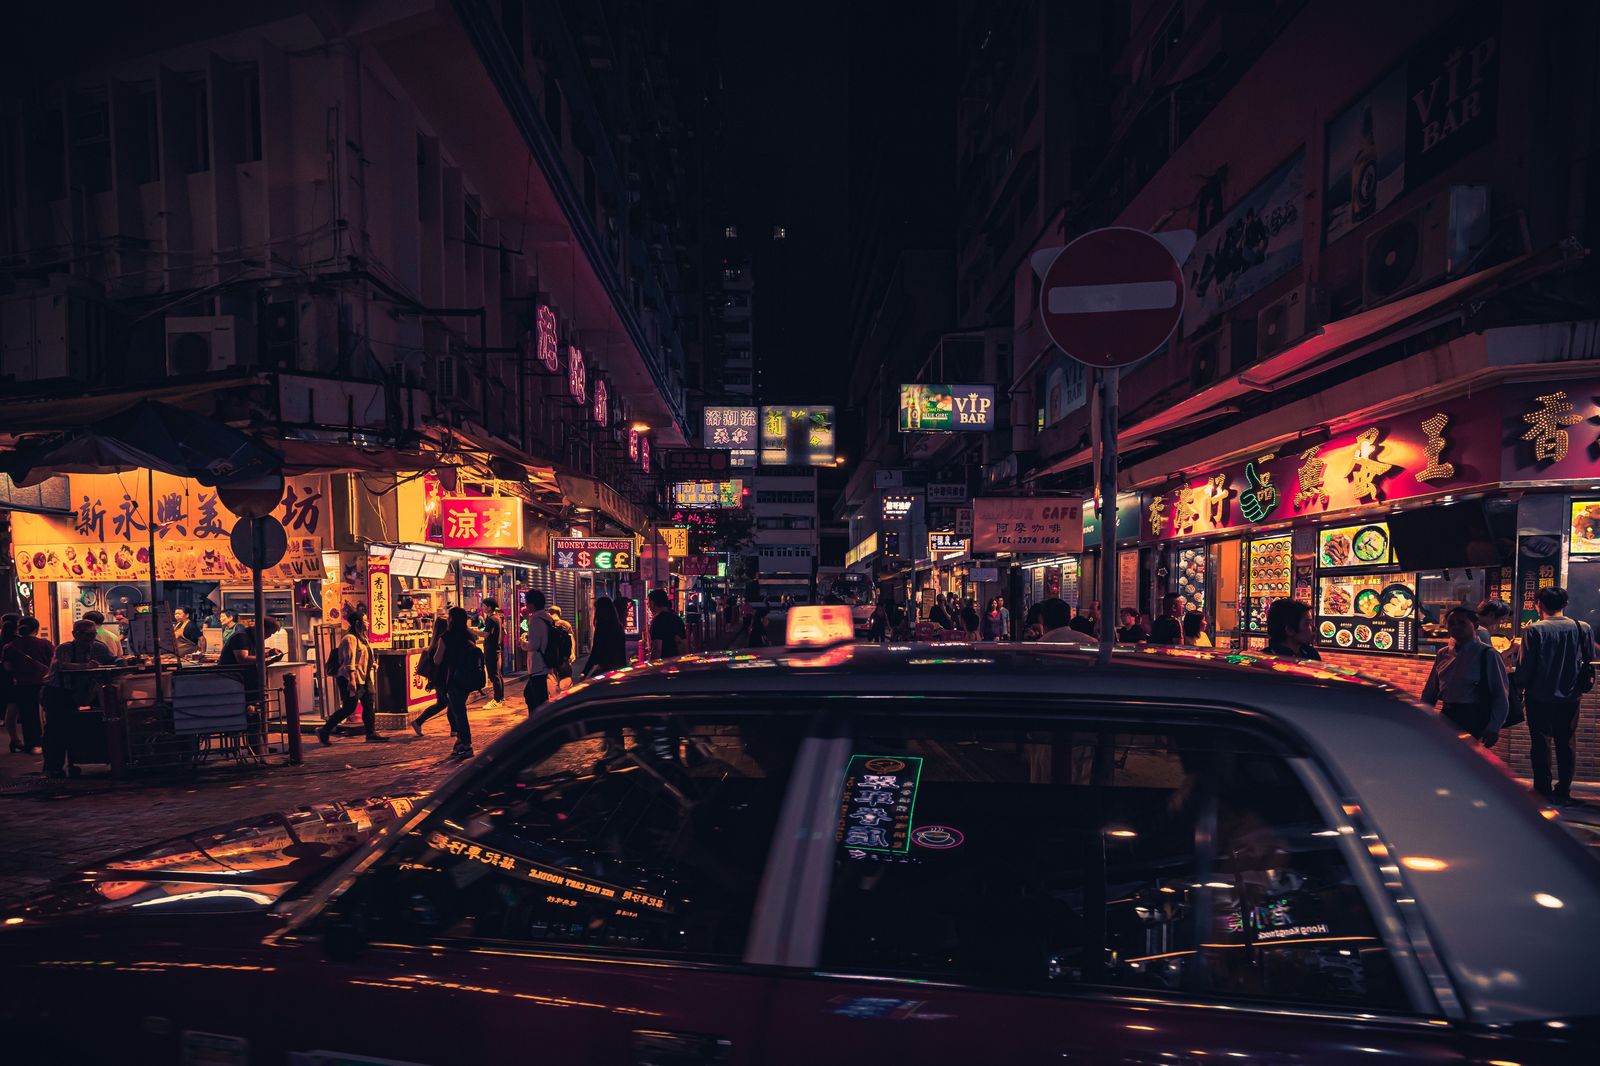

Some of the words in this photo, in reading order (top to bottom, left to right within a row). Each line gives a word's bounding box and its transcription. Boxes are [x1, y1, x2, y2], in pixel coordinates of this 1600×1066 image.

[1412, 37, 1494, 124] VIP
[1421, 92, 1481, 152] BAR
[954, 397, 992, 413] VIP
[1066, 383, 1082, 405] BAR
[959, 413, 986, 424] BAR
[1521, 391, 1600, 462] 香
[75, 485, 322, 542] 新永興美坊
[447, 508, 513, 539] 涼茶
[1042, 507, 1078, 520] CAFE
[557, 541, 585, 550] MONEY
[587, 541, 630, 550] EXCHANGE
[374, 577, 386, 630] 香港涼茶
